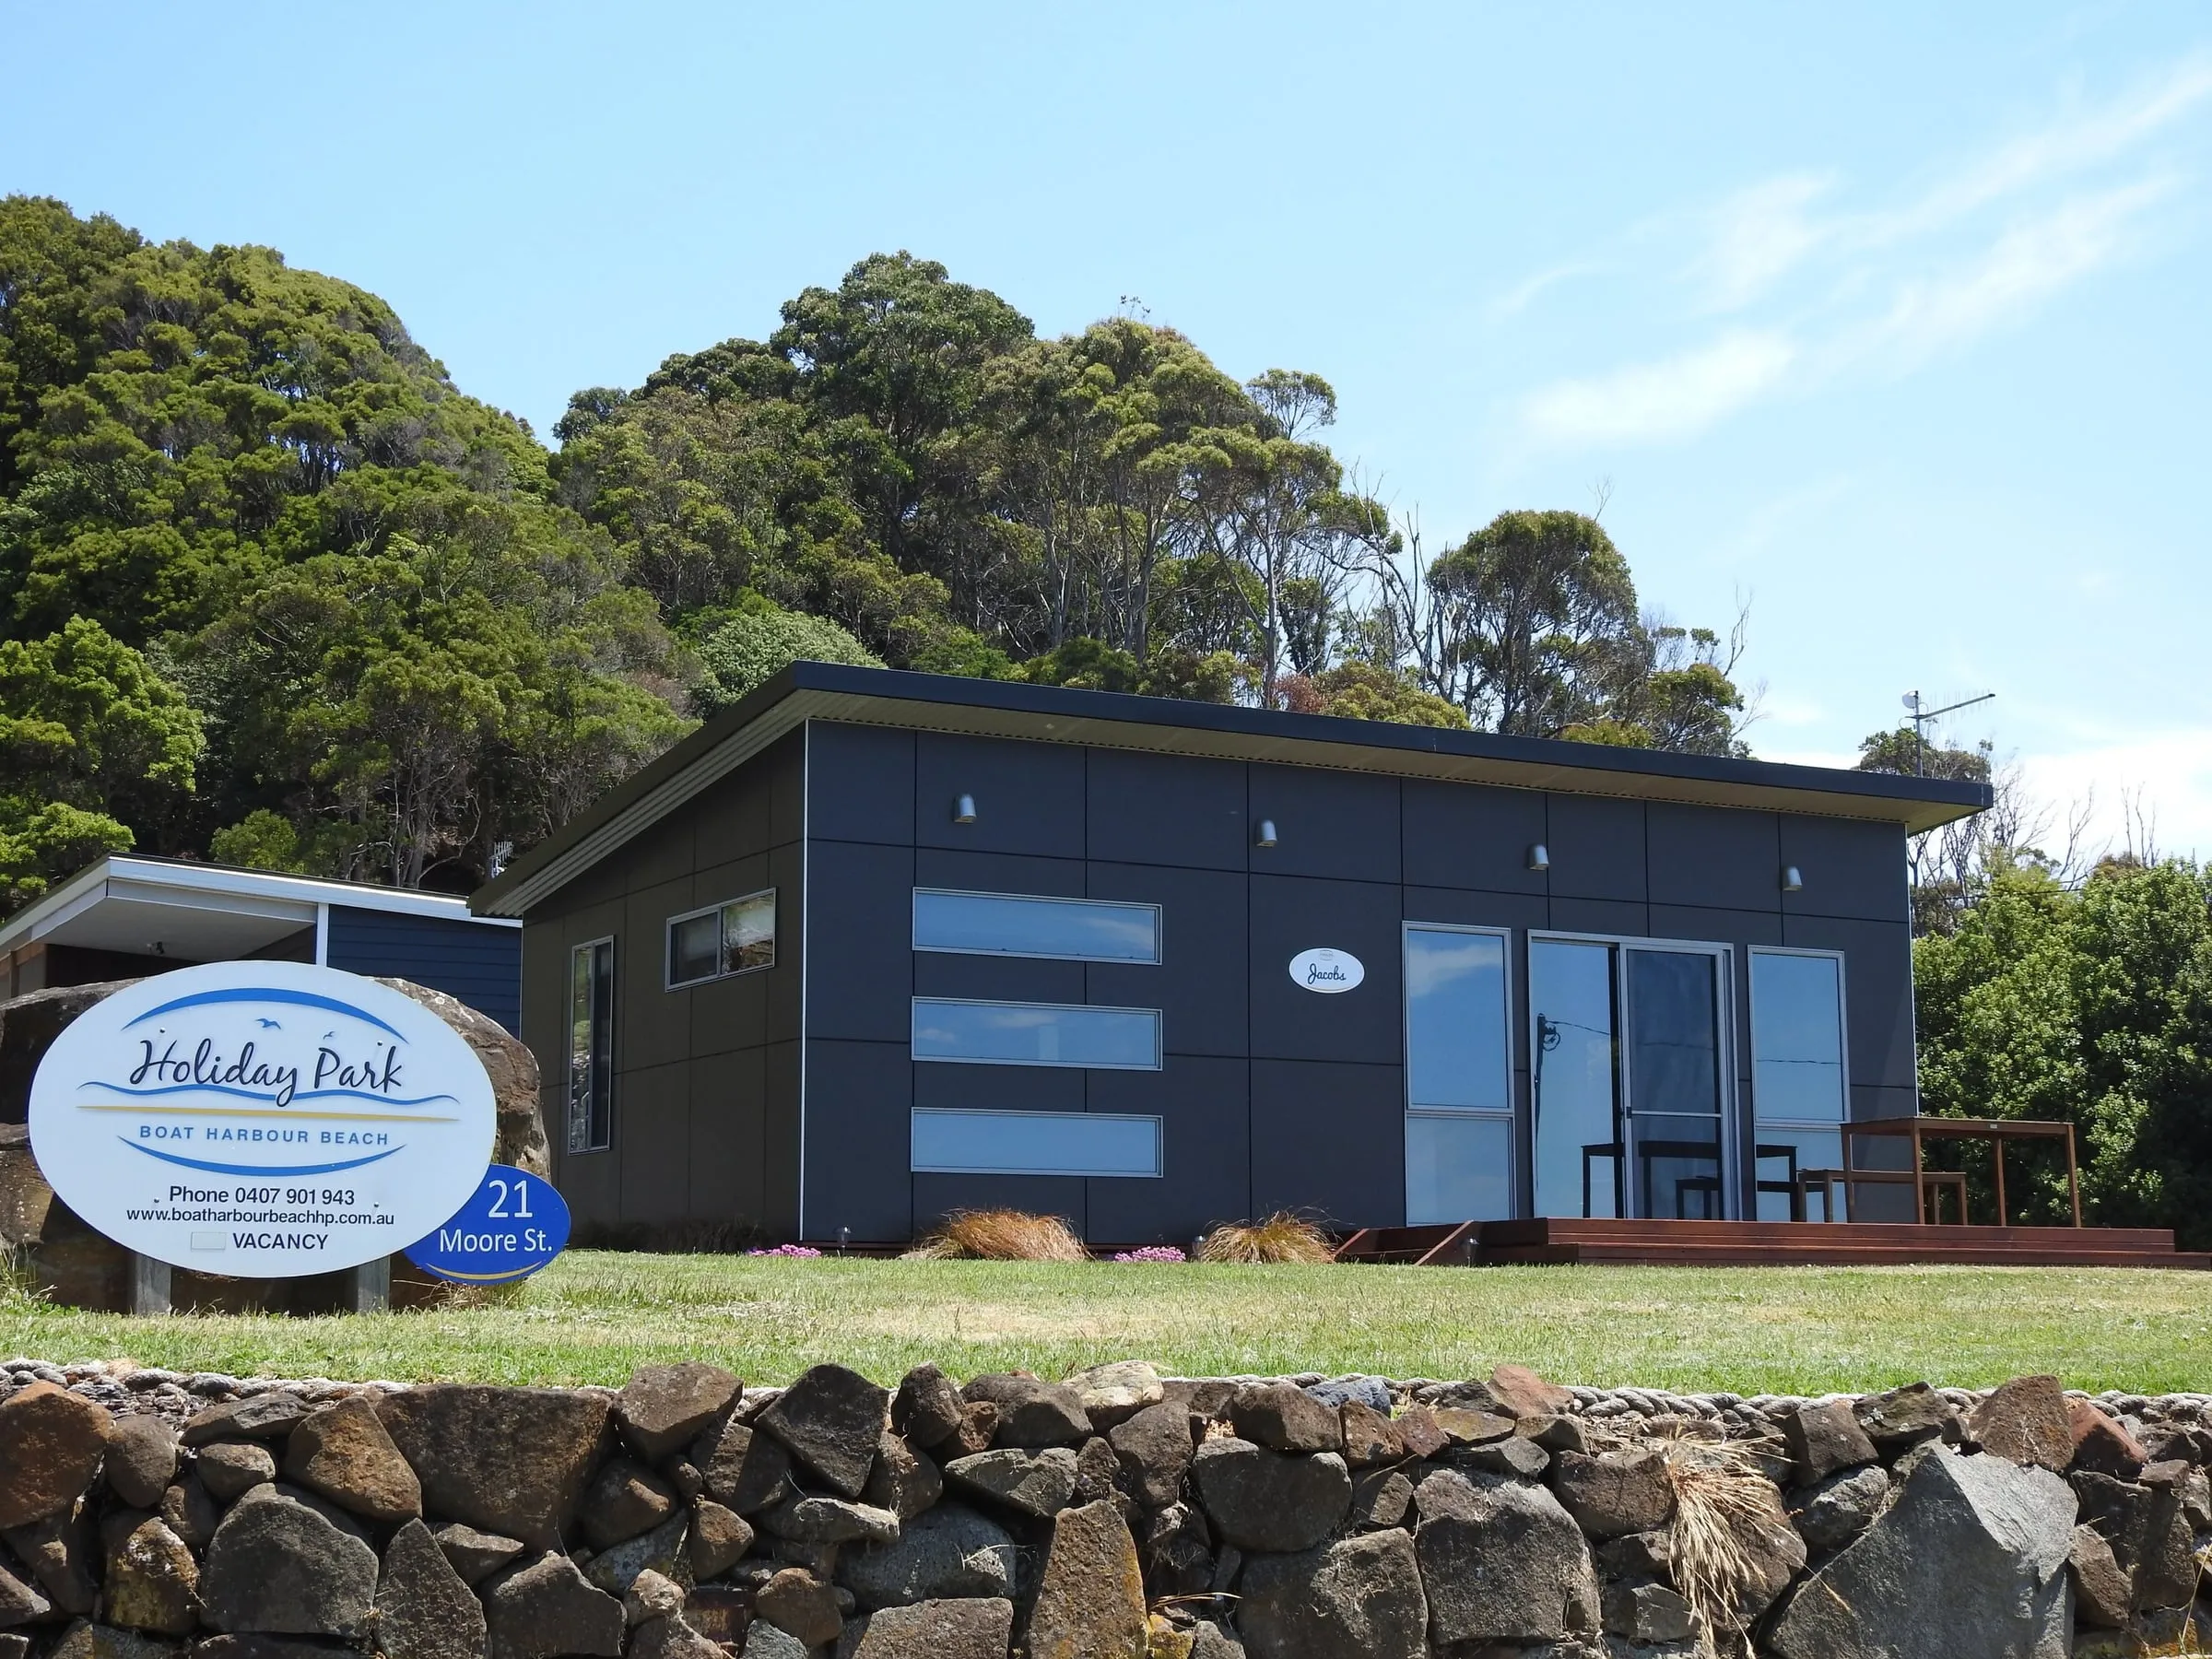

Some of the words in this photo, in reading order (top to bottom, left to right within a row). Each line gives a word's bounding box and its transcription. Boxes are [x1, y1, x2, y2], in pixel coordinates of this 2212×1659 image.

[1308, 963, 1347, 984] Jacobs
[129, 1038, 298, 1108] Holiday
[313, 1045, 403, 1094] Park
[139, 1125, 194, 1140] BOAT
[206, 1127, 309, 1143] HARBOUR
[321, 1132, 388, 1146] BEACH
[169, 1185, 229, 1203] Phone
[235, 1187, 281, 1204] 0407
[287, 1189, 315, 1205] 901
[322, 1190, 355, 1206] 943
[488, 1180, 534, 1218] 21
[126, 1207, 394, 1227] www.boatharbourbeachhp.com.au
[232, 1232, 329, 1250] VACANCY
[440, 1229, 517, 1253] Moore
[524, 1228, 553, 1253] St.
